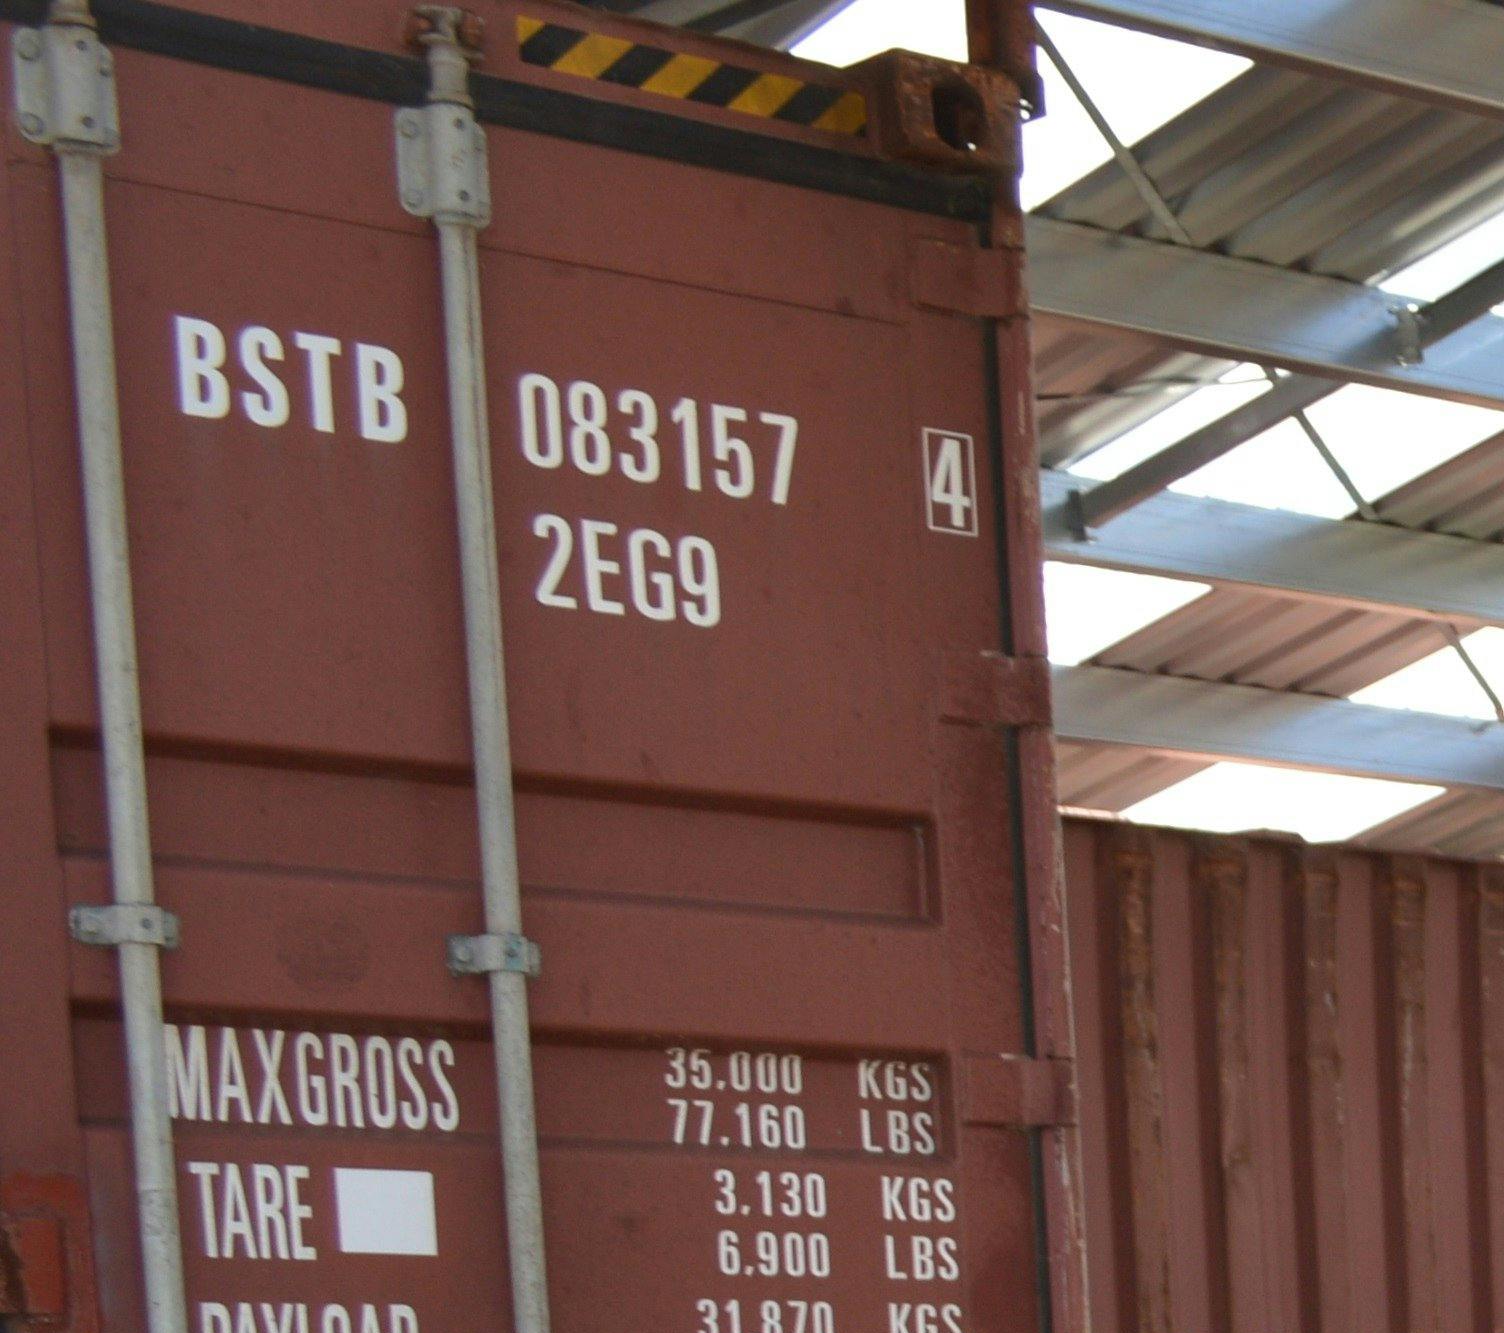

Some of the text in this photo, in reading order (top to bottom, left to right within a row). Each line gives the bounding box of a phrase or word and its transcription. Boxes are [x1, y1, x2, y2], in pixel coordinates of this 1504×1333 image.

[174, 315, 973, 529] BSTB 083157 4
[532, 512, 720, 628] 2EG9
[163, 1022, 461, 1132] MAXGROSS
[664, 1047, 932, 1102] 35.000 KGS
[666, 1098, 935, 1155] 77.160 LBS
[188, 1161, 317, 1261] TARE
[713, 1168, 956, 1223] 3.130 KGS
[717, 1229, 959, 1281] 6.900 LBS
